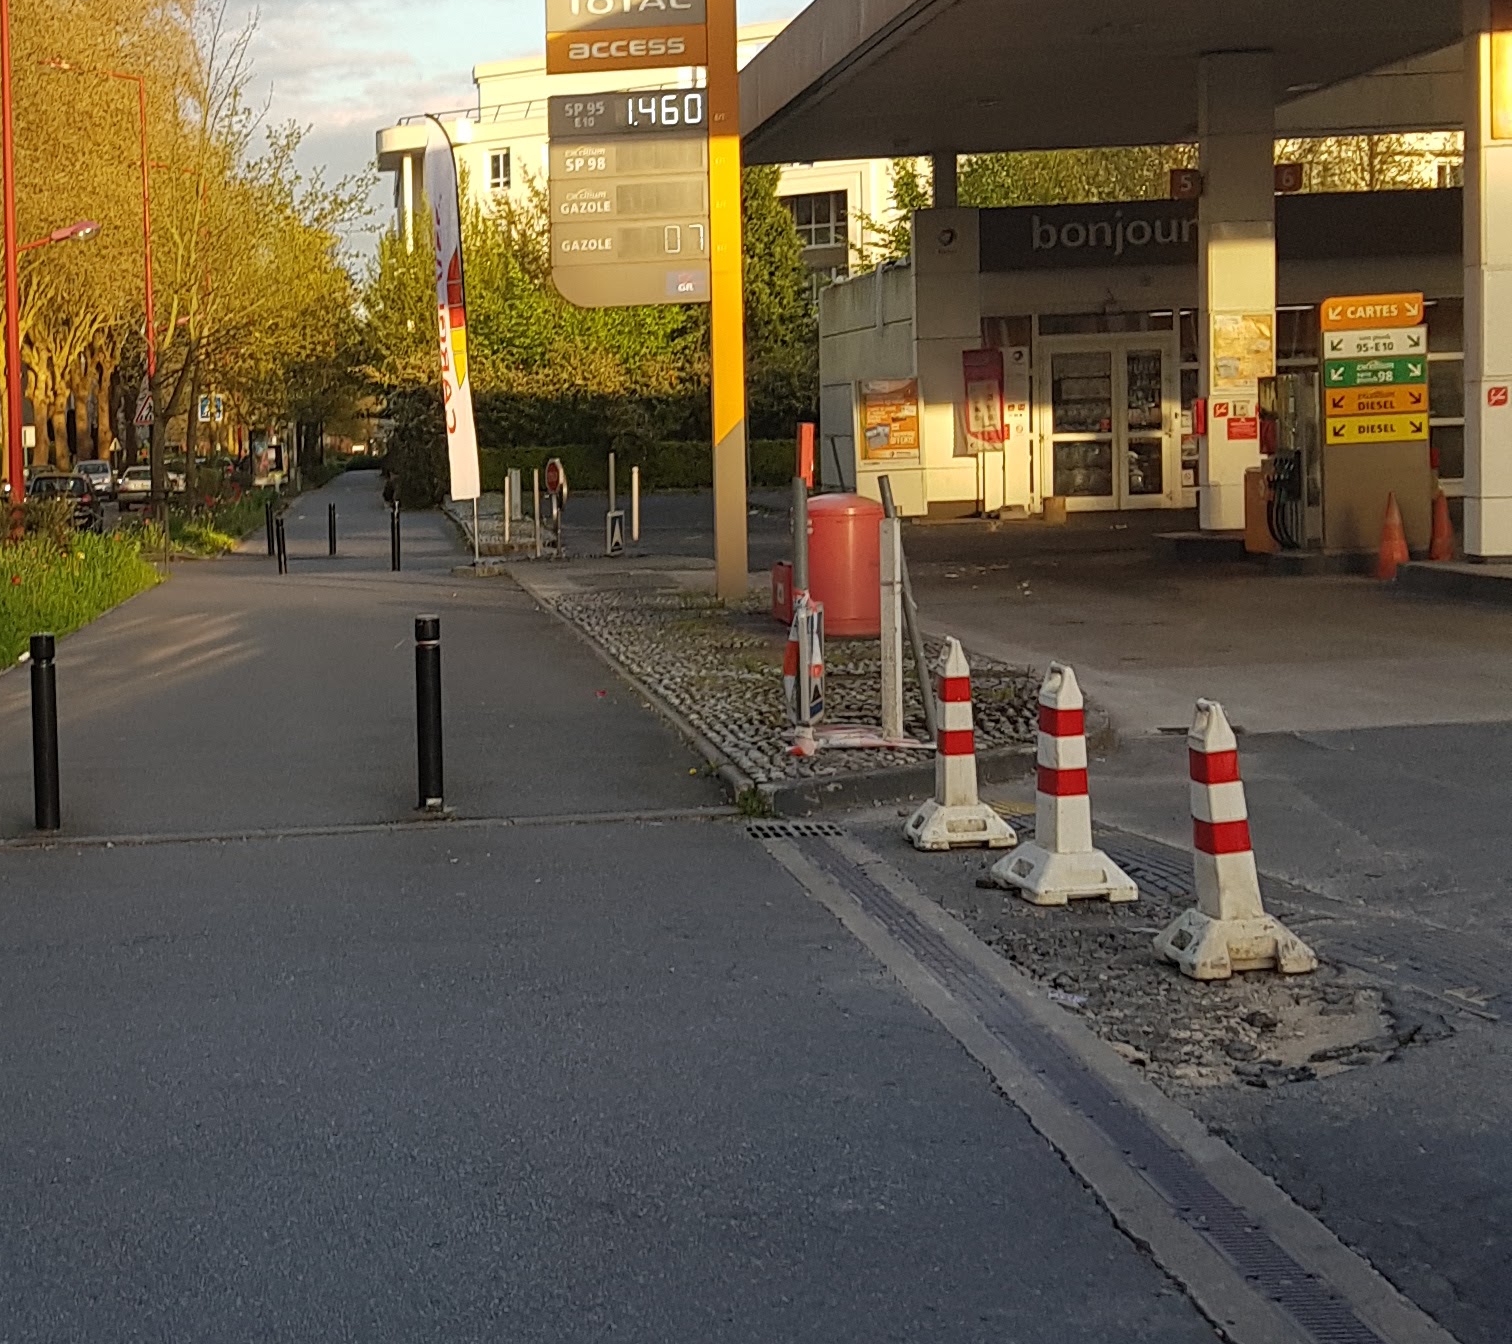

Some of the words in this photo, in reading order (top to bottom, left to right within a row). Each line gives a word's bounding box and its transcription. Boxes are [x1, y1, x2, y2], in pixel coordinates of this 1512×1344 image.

[564, 102, 584, 117] SP
[586, 100, 605, 116] 95
[627, 92, 703, 127] 1.460
[574, 116, 595, 128] E10
[565, 158, 585, 173] SP
[587, 156, 606, 171] 98
[1180, 174, 1193, 192] 5
[1281, 169, 1292, 187] 6
[560, 200, 611, 215] GAZOLE
[1031, 209, 1199, 256] bonjour
[561, 237, 613, 253] GAZOLE
[1346, 304, 1399, 319] CARTES
[1377, 370, 1394, 383] 98
[1358, 400, 1395, 411] DIESEL
[1358, 424, 1397, 435] DIESEL
